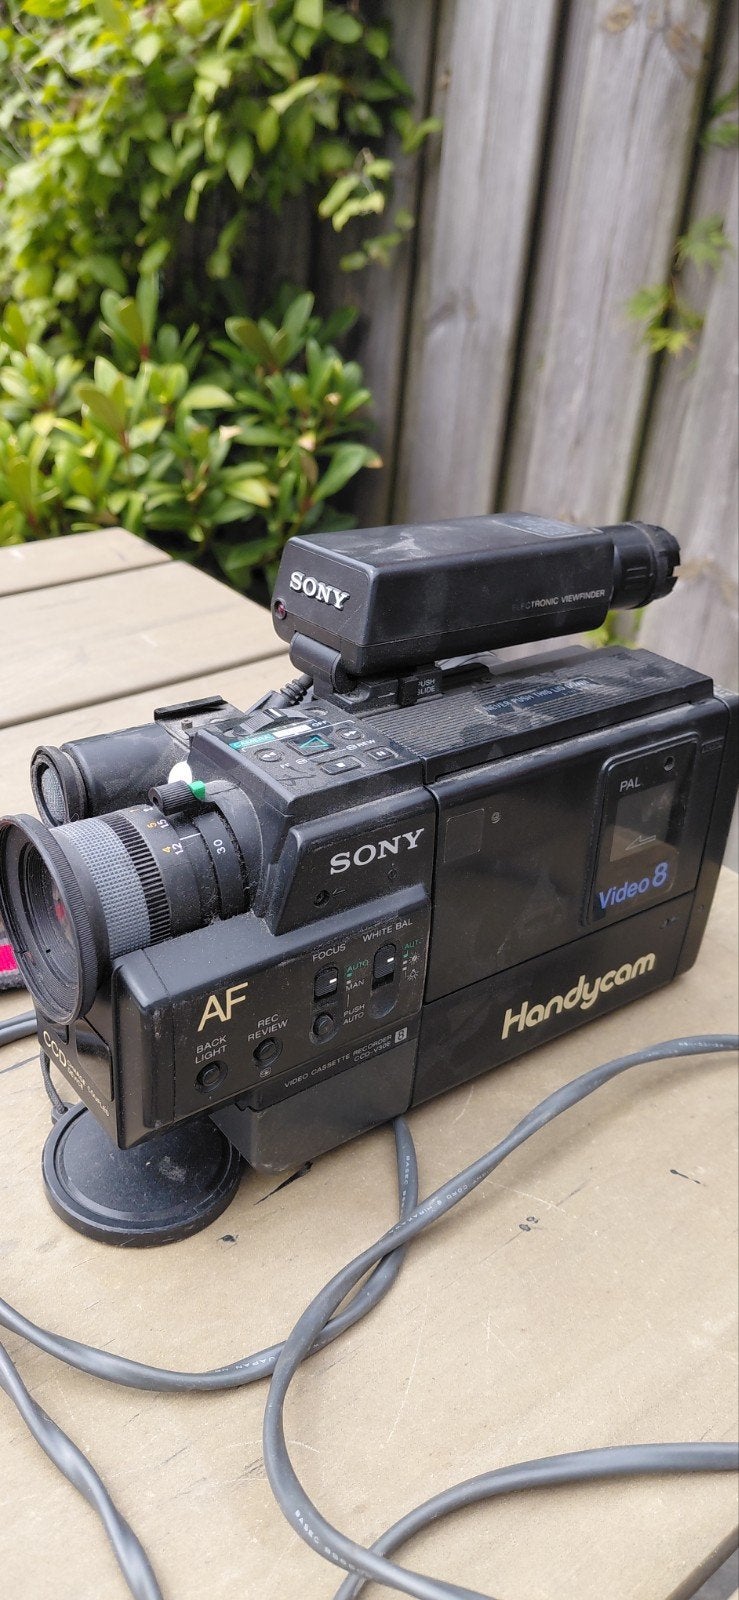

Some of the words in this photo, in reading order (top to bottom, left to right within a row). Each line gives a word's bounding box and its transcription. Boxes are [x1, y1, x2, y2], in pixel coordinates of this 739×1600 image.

[290, 571, 350, 610] SONY
[561, 589, 606, 604] VIEWFINDER
[620, 777, 641, 792] PAL
[213, 839, 226, 855] 30
[330, 828, 425, 875] SONY
[599, 877, 649, 910] Video
[652, 862, 668, 887] 8
[362, 926, 393, 942] WHITE
[395, 918, 413, 931] BAL
[312, 943, 346, 962] FOCUS
[346, 959, 369, 972] AUTO
[346, 979, 366, 991] MAN
[197, 981, 249, 1032] AF
[501, 953, 656, 1040] Handycam
[342, 1011, 365, 1026] AUTO
[343, 1003, 366, 1018] PUSH
[247, 1019, 288, 1041] REVIEW
[257, 1014, 279, 1028] REC
[43, 1031, 67, 1067] CCD
[196, 1034, 227, 1054] BACK
[195, 1044, 228, 1065] LIGHT
[284, 1072, 309, 1088] VIDEO
[310, 1053, 351, 1076] CASSETTE
[352, 1034, 393, 1056] RECORDER
[235, 1356, 275, 1370] JAPAN
